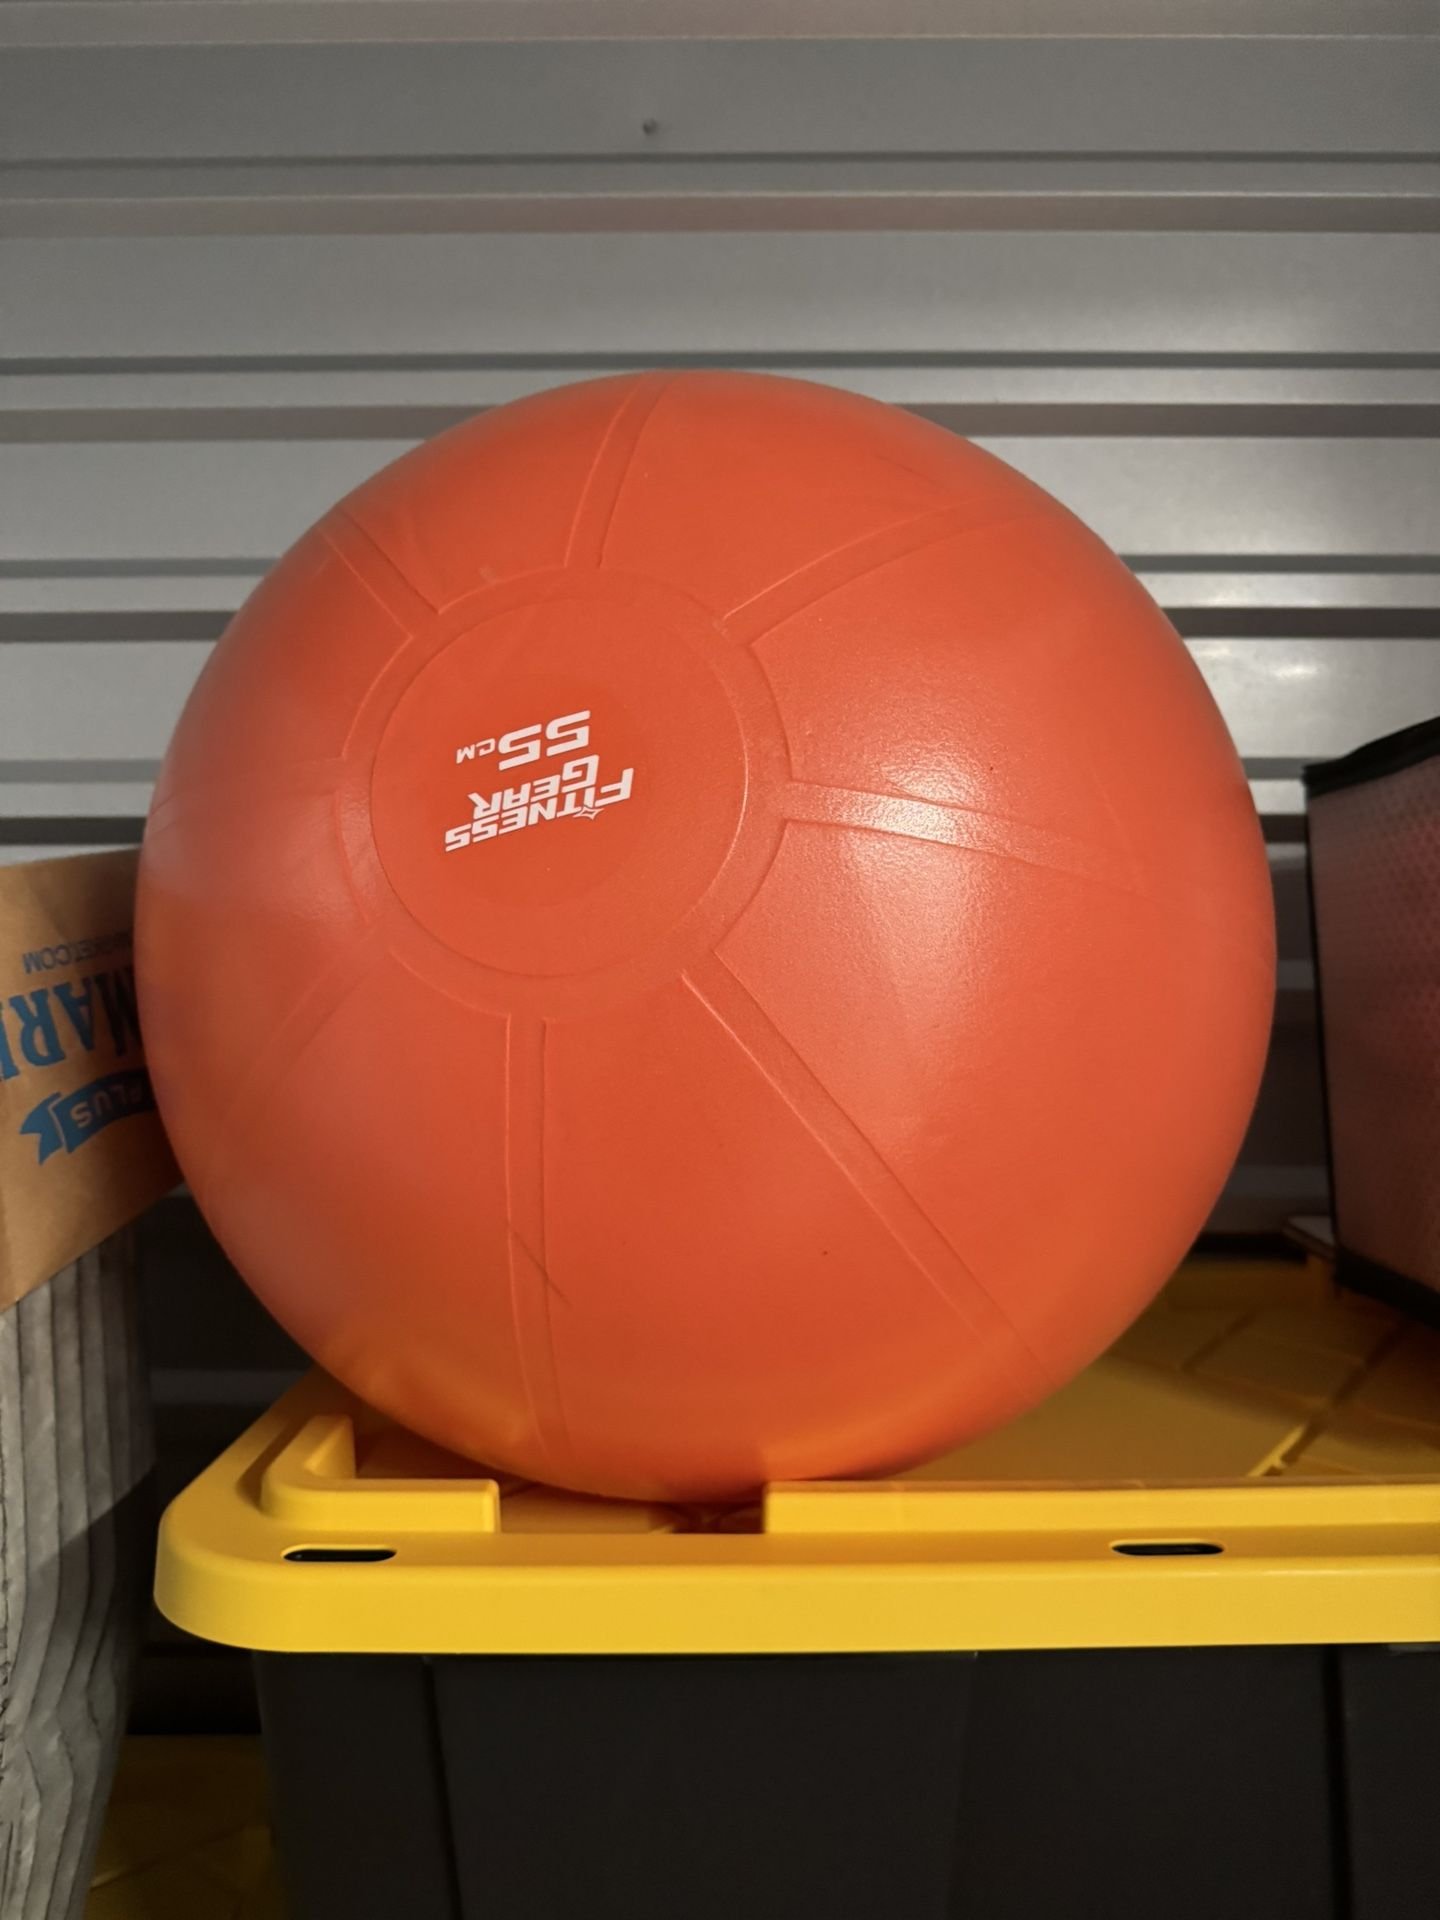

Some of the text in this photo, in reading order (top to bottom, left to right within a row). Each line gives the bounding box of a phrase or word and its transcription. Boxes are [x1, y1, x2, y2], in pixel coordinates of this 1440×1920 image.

[445, 767, 634, 852] FITNESS
[468, 754, 600, 820] GEAR
[69, 1080, 143, 1129] PLUS
